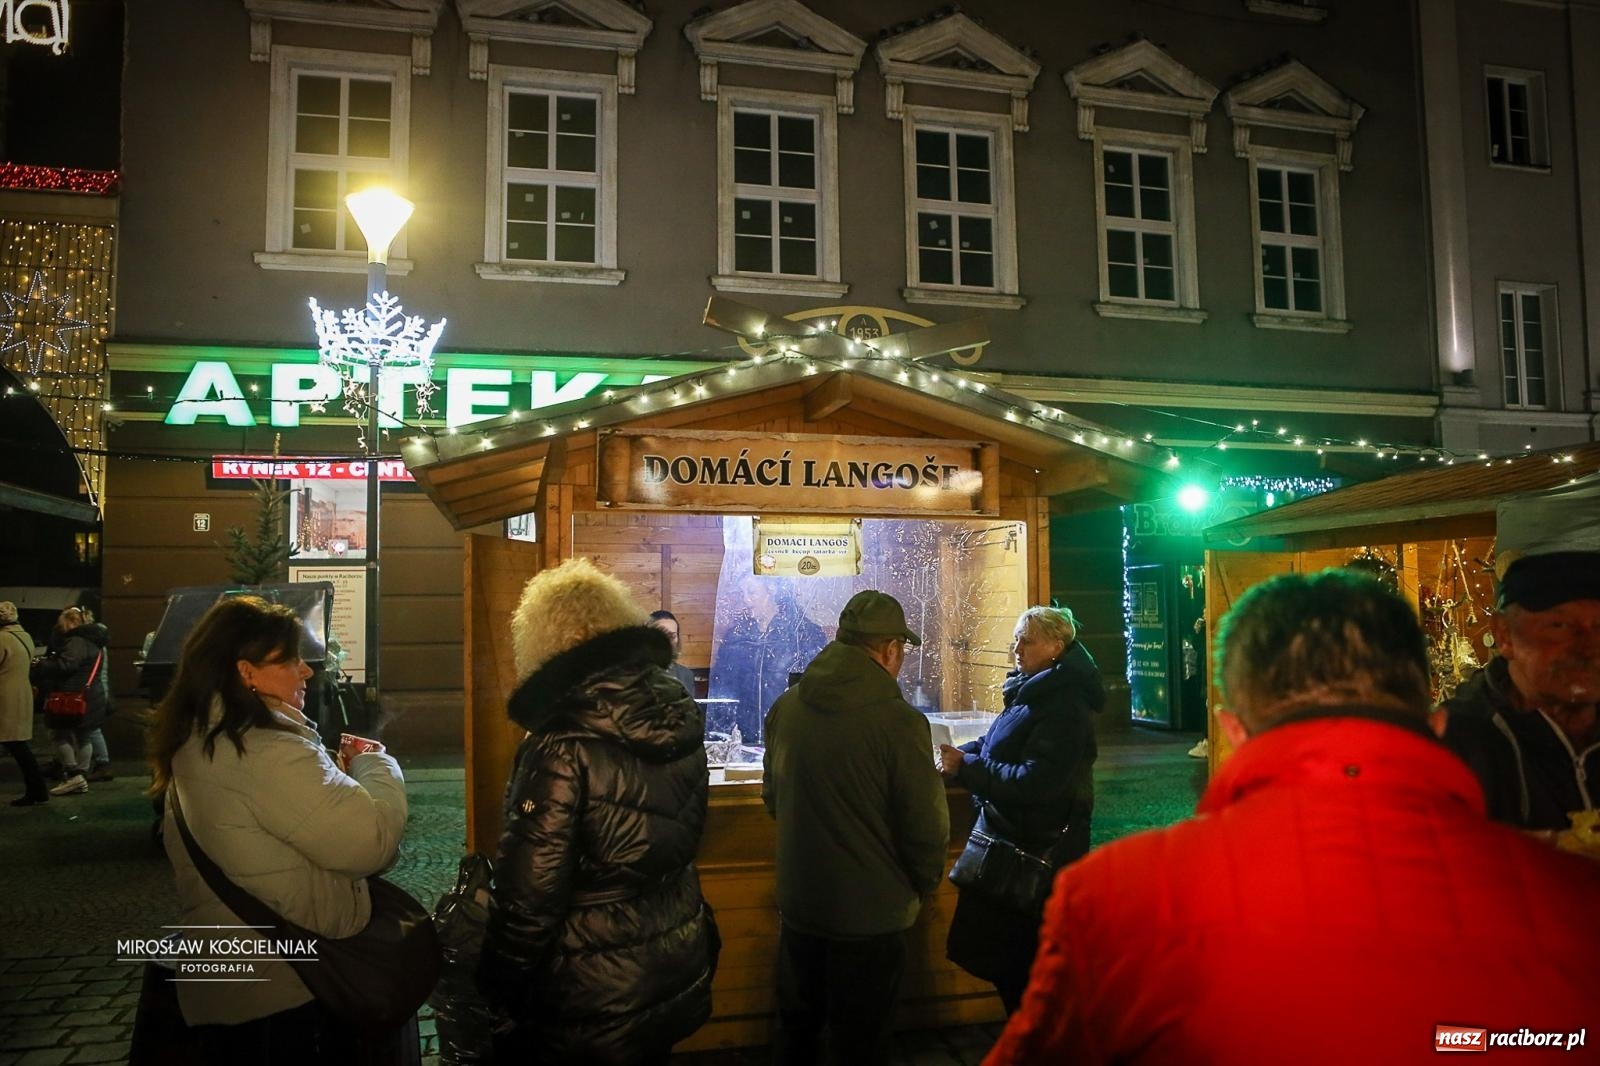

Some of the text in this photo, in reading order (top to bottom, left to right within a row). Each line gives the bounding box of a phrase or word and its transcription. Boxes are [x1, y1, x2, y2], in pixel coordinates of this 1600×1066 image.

[164, 361, 673, 428] APTEK
[304, 462, 332, 477] 12
[643, 449, 792, 487] DOMÁCÍ
[196, 519, 206, 528] 12
